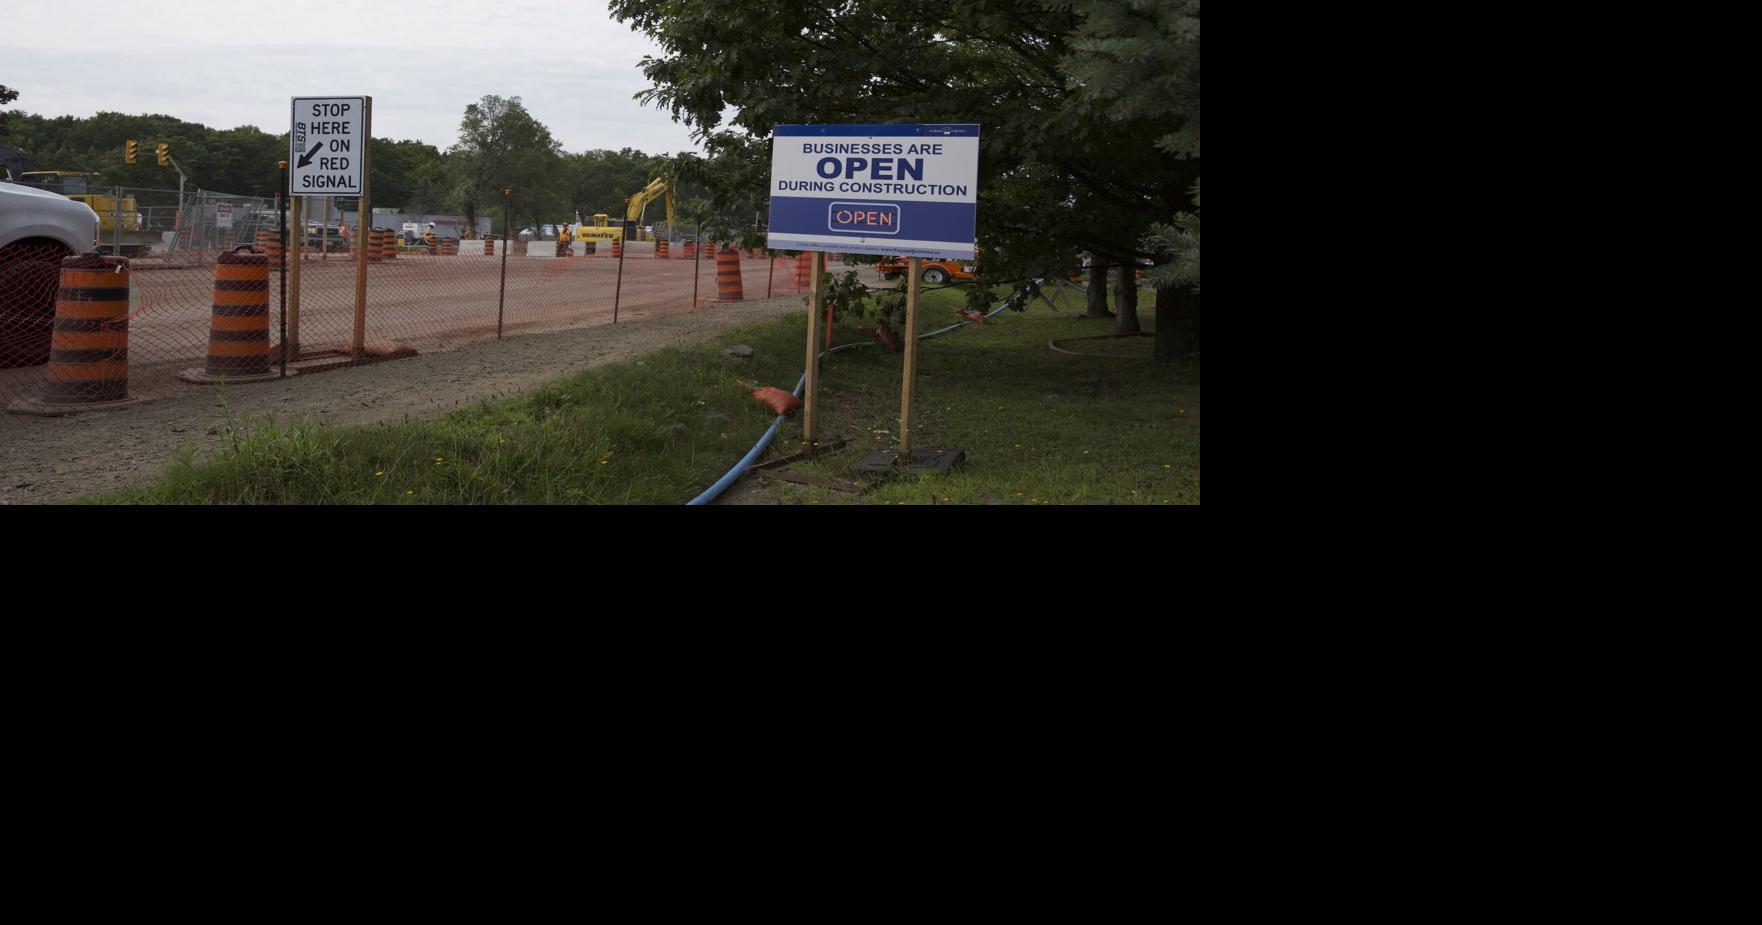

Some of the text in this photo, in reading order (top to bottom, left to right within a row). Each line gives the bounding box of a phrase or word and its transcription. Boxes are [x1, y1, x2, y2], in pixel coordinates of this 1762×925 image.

[312, 103, 351, 117] STOP
[297, 122, 306, 142] BTS
[310, 121, 351, 135] HERE
[329, 139, 350, 153] ON
[802, 143, 943, 155] BUSINESSES ARE
[320, 157, 350, 170] RED
[816, 156, 924, 181] OPEN
[302, 174, 357, 188] SIGNAL
[778, 180, 967, 196] DURING CONSTRUCTION
[836, 210, 892, 226] OPEN
